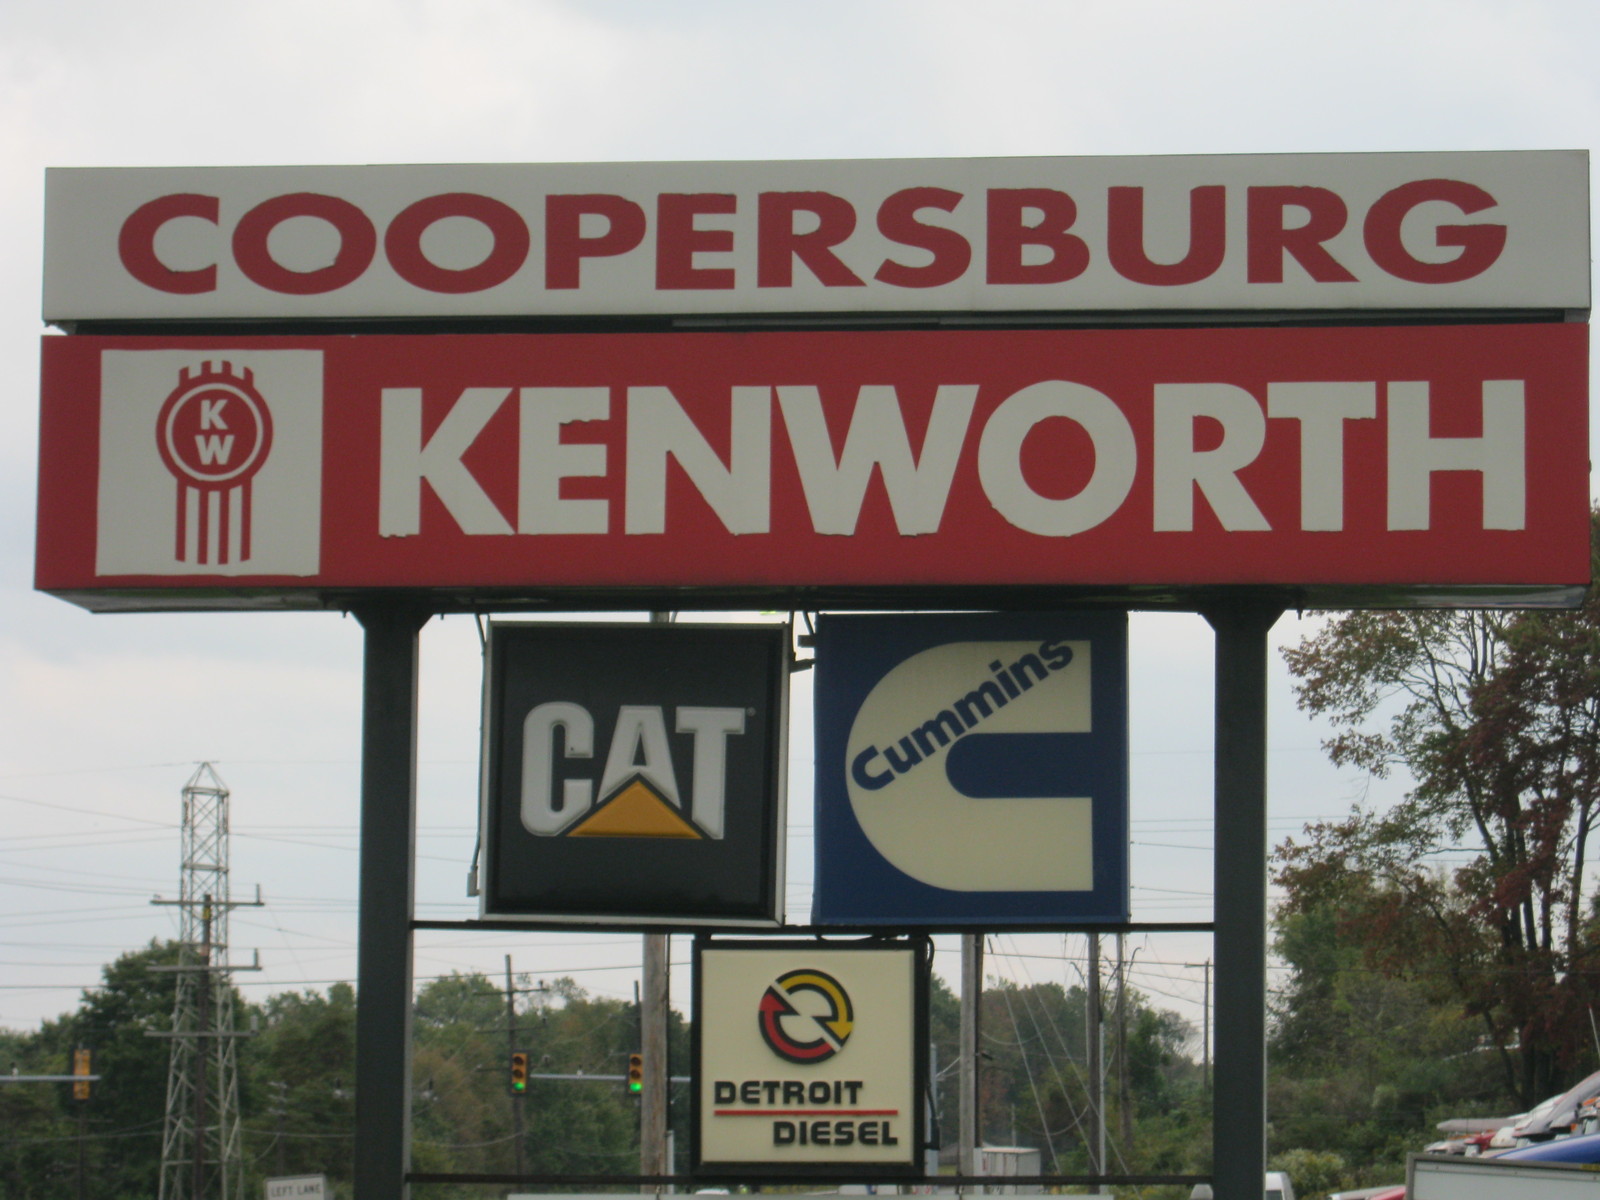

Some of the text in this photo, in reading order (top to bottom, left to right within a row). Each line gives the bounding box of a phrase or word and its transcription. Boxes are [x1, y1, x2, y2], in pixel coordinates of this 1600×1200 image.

[118, 178, 1508, 296] COOPERSBURG
[378, 379, 1526, 538] KENWORTH
[520, 701, 746, 840] CAT
[851, 638, 1074, 792] Cummins
[714, 1080, 864, 1105] DETROIT
[773, 1121, 899, 1146] DIESEL
[270, 1182, 322, 1198] LEFT LANE
